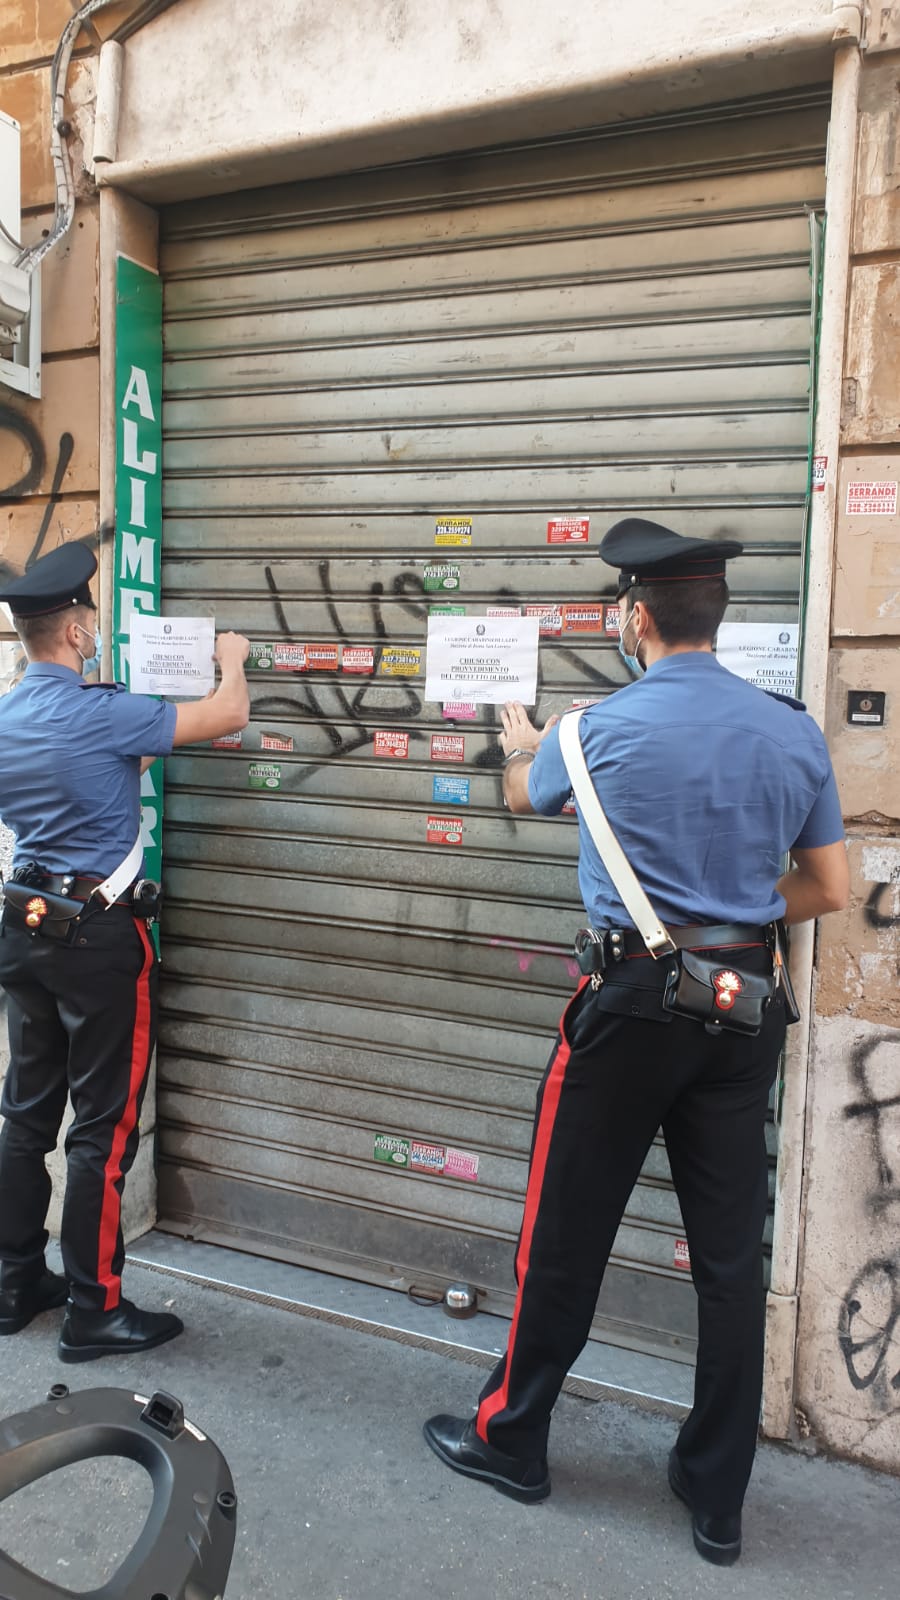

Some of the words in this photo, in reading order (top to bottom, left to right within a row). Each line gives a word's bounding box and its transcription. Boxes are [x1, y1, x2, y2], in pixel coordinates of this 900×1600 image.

[849, 488, 896, 496] SERRANDE
[746, 677, 795, 685] PROVVEDIM
[375, 732, 408, 740] SERRANDE
